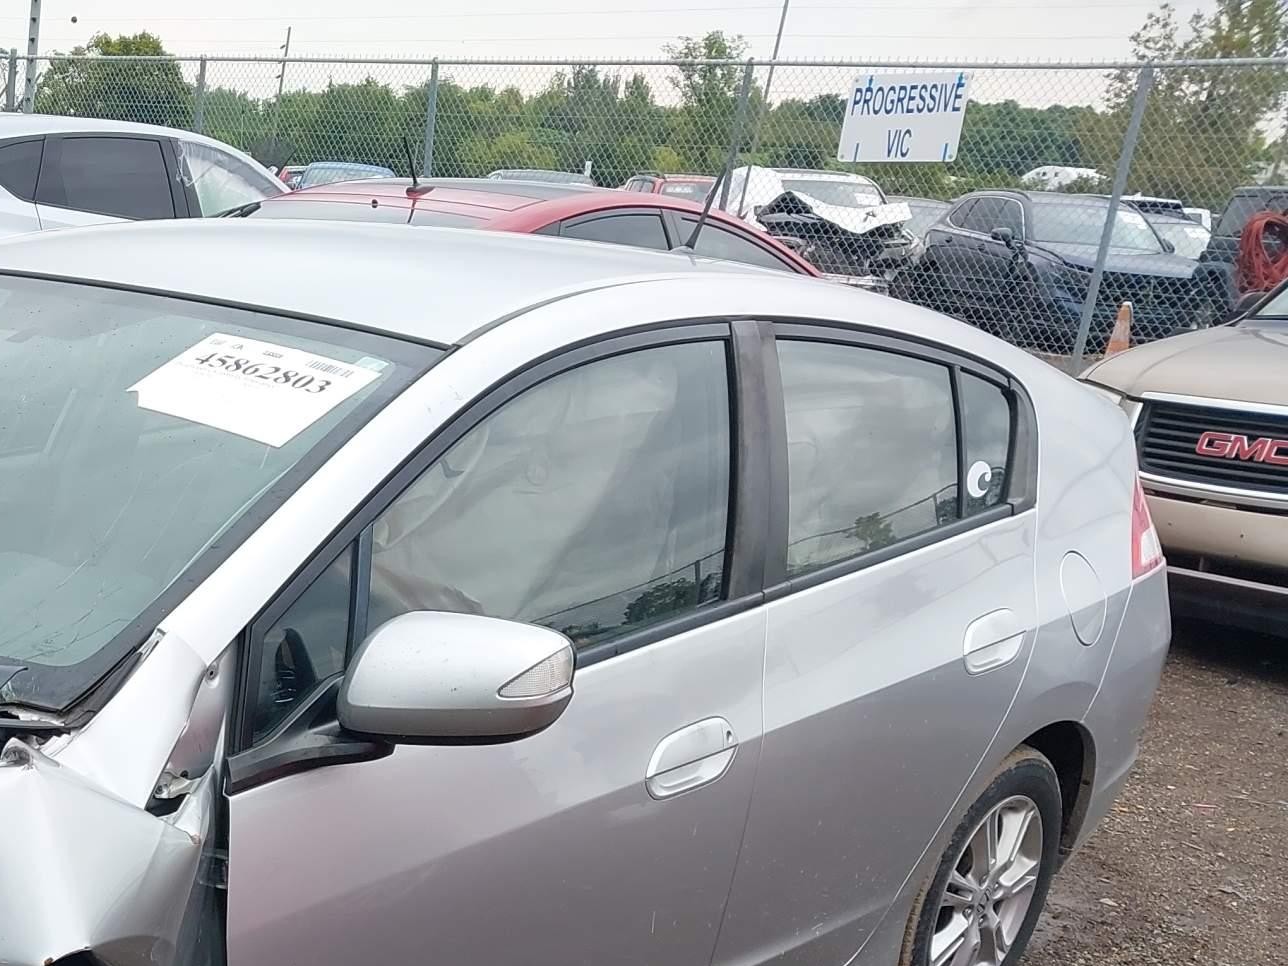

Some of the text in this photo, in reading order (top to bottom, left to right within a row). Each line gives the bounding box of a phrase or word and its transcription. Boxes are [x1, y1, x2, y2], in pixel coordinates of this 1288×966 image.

[851, 82, 965, 116] PROGRESSIVE
[886, 129, 912, 158] VIC
[195, 352, 332, 394] 45862803
[1196, 431, 1288, 465] GMC
